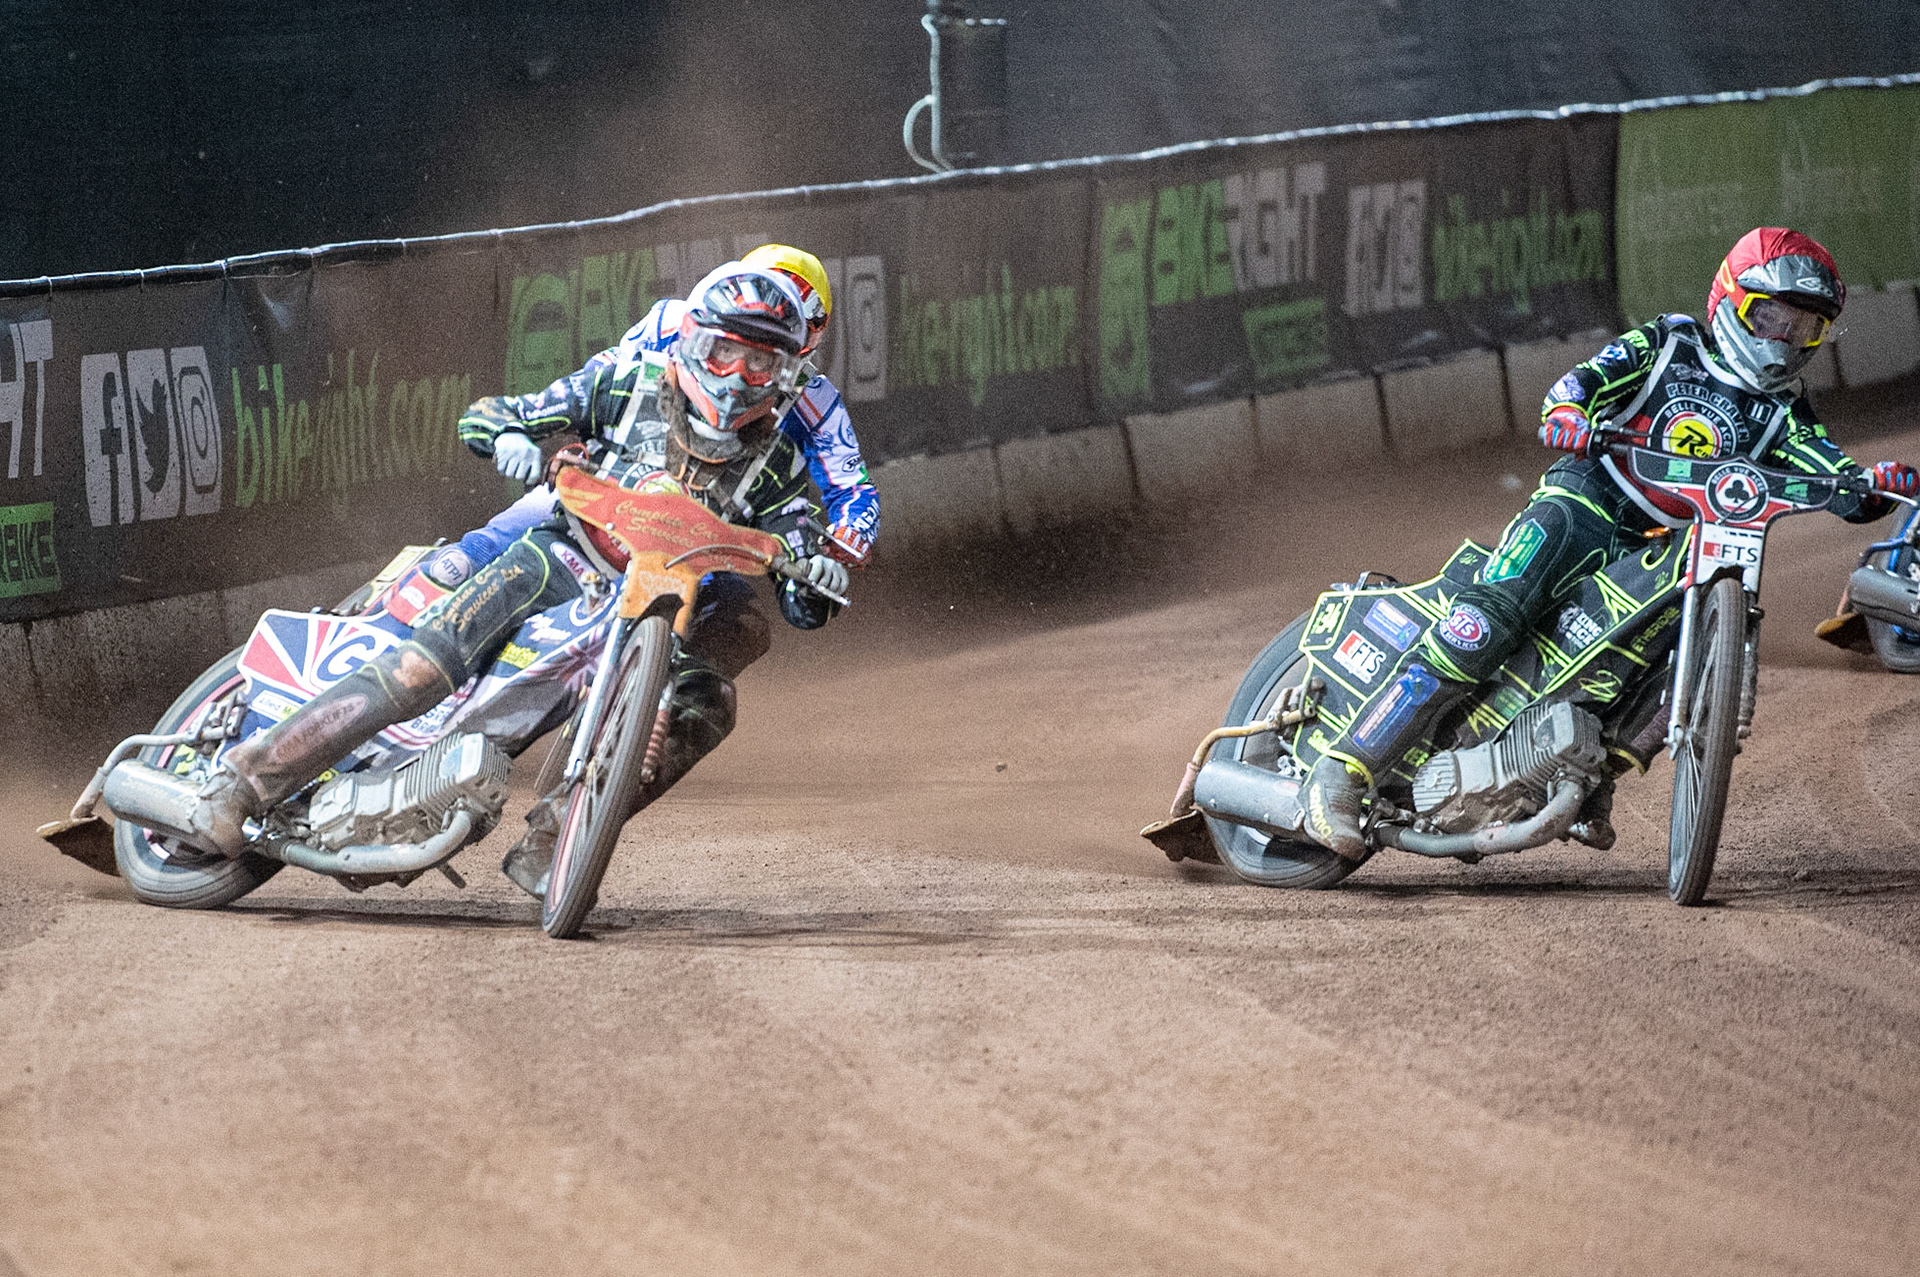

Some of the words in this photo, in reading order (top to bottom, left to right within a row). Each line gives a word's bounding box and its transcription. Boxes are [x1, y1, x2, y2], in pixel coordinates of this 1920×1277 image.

[1665, 382, 1709, 400] PETER
[1664, 402, 1696, 418] BELLE
[1701, 405, 1719, 425] VUE
[1712, 467, 1732, 484] BELLE
[1733, 467, 1750, 475] VUE
[1751, 474, 1765, 492] ACES
[562, 550, 585, 576] KMA
[1721, 543, 1758, 563] FTS
[441, 559, 462, 580] ATPI
[1450, 614, 1476, 637] STS
[1351, 641, 1384, 674] FTS
